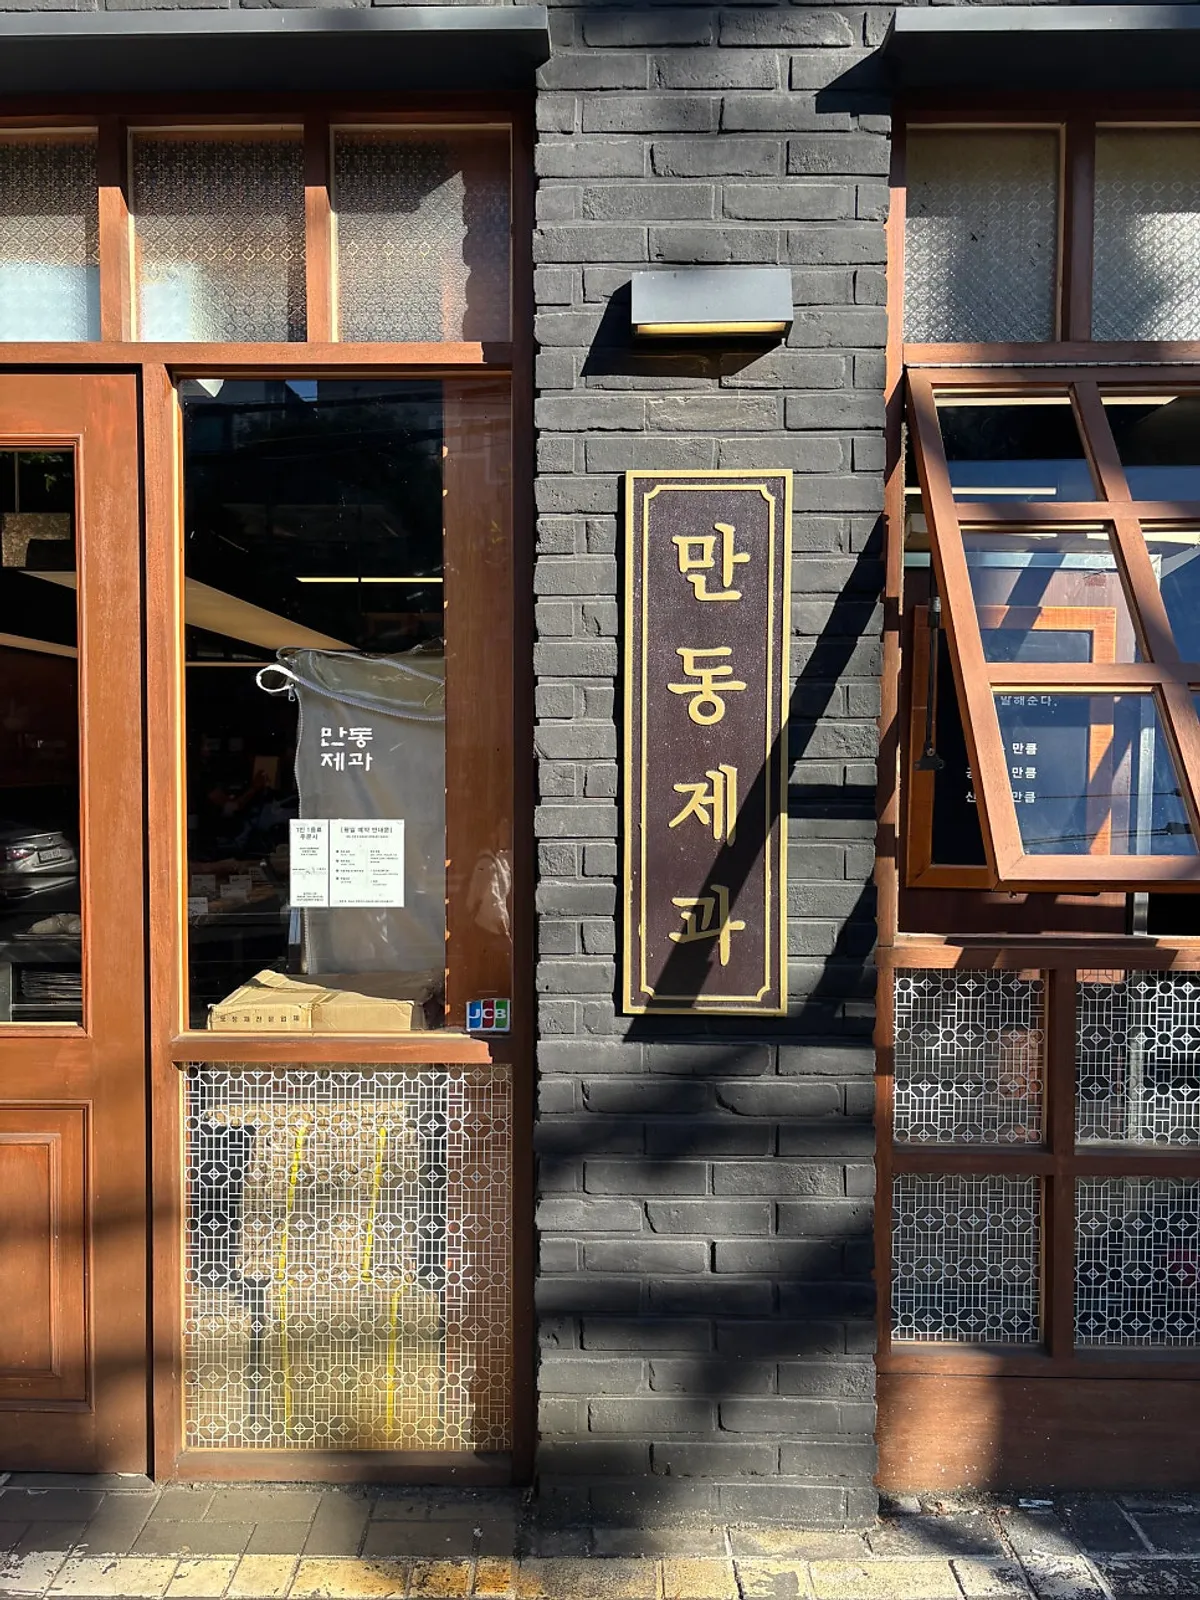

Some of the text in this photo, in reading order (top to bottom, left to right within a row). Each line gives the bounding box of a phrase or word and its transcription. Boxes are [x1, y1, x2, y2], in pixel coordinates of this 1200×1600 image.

[320, 726, 374, 749] 만동
[667, 522, 751, 967] 만동제과
[1012, 742, 1038, 755] 만큼
[320, 752, 374, 772] 제과
